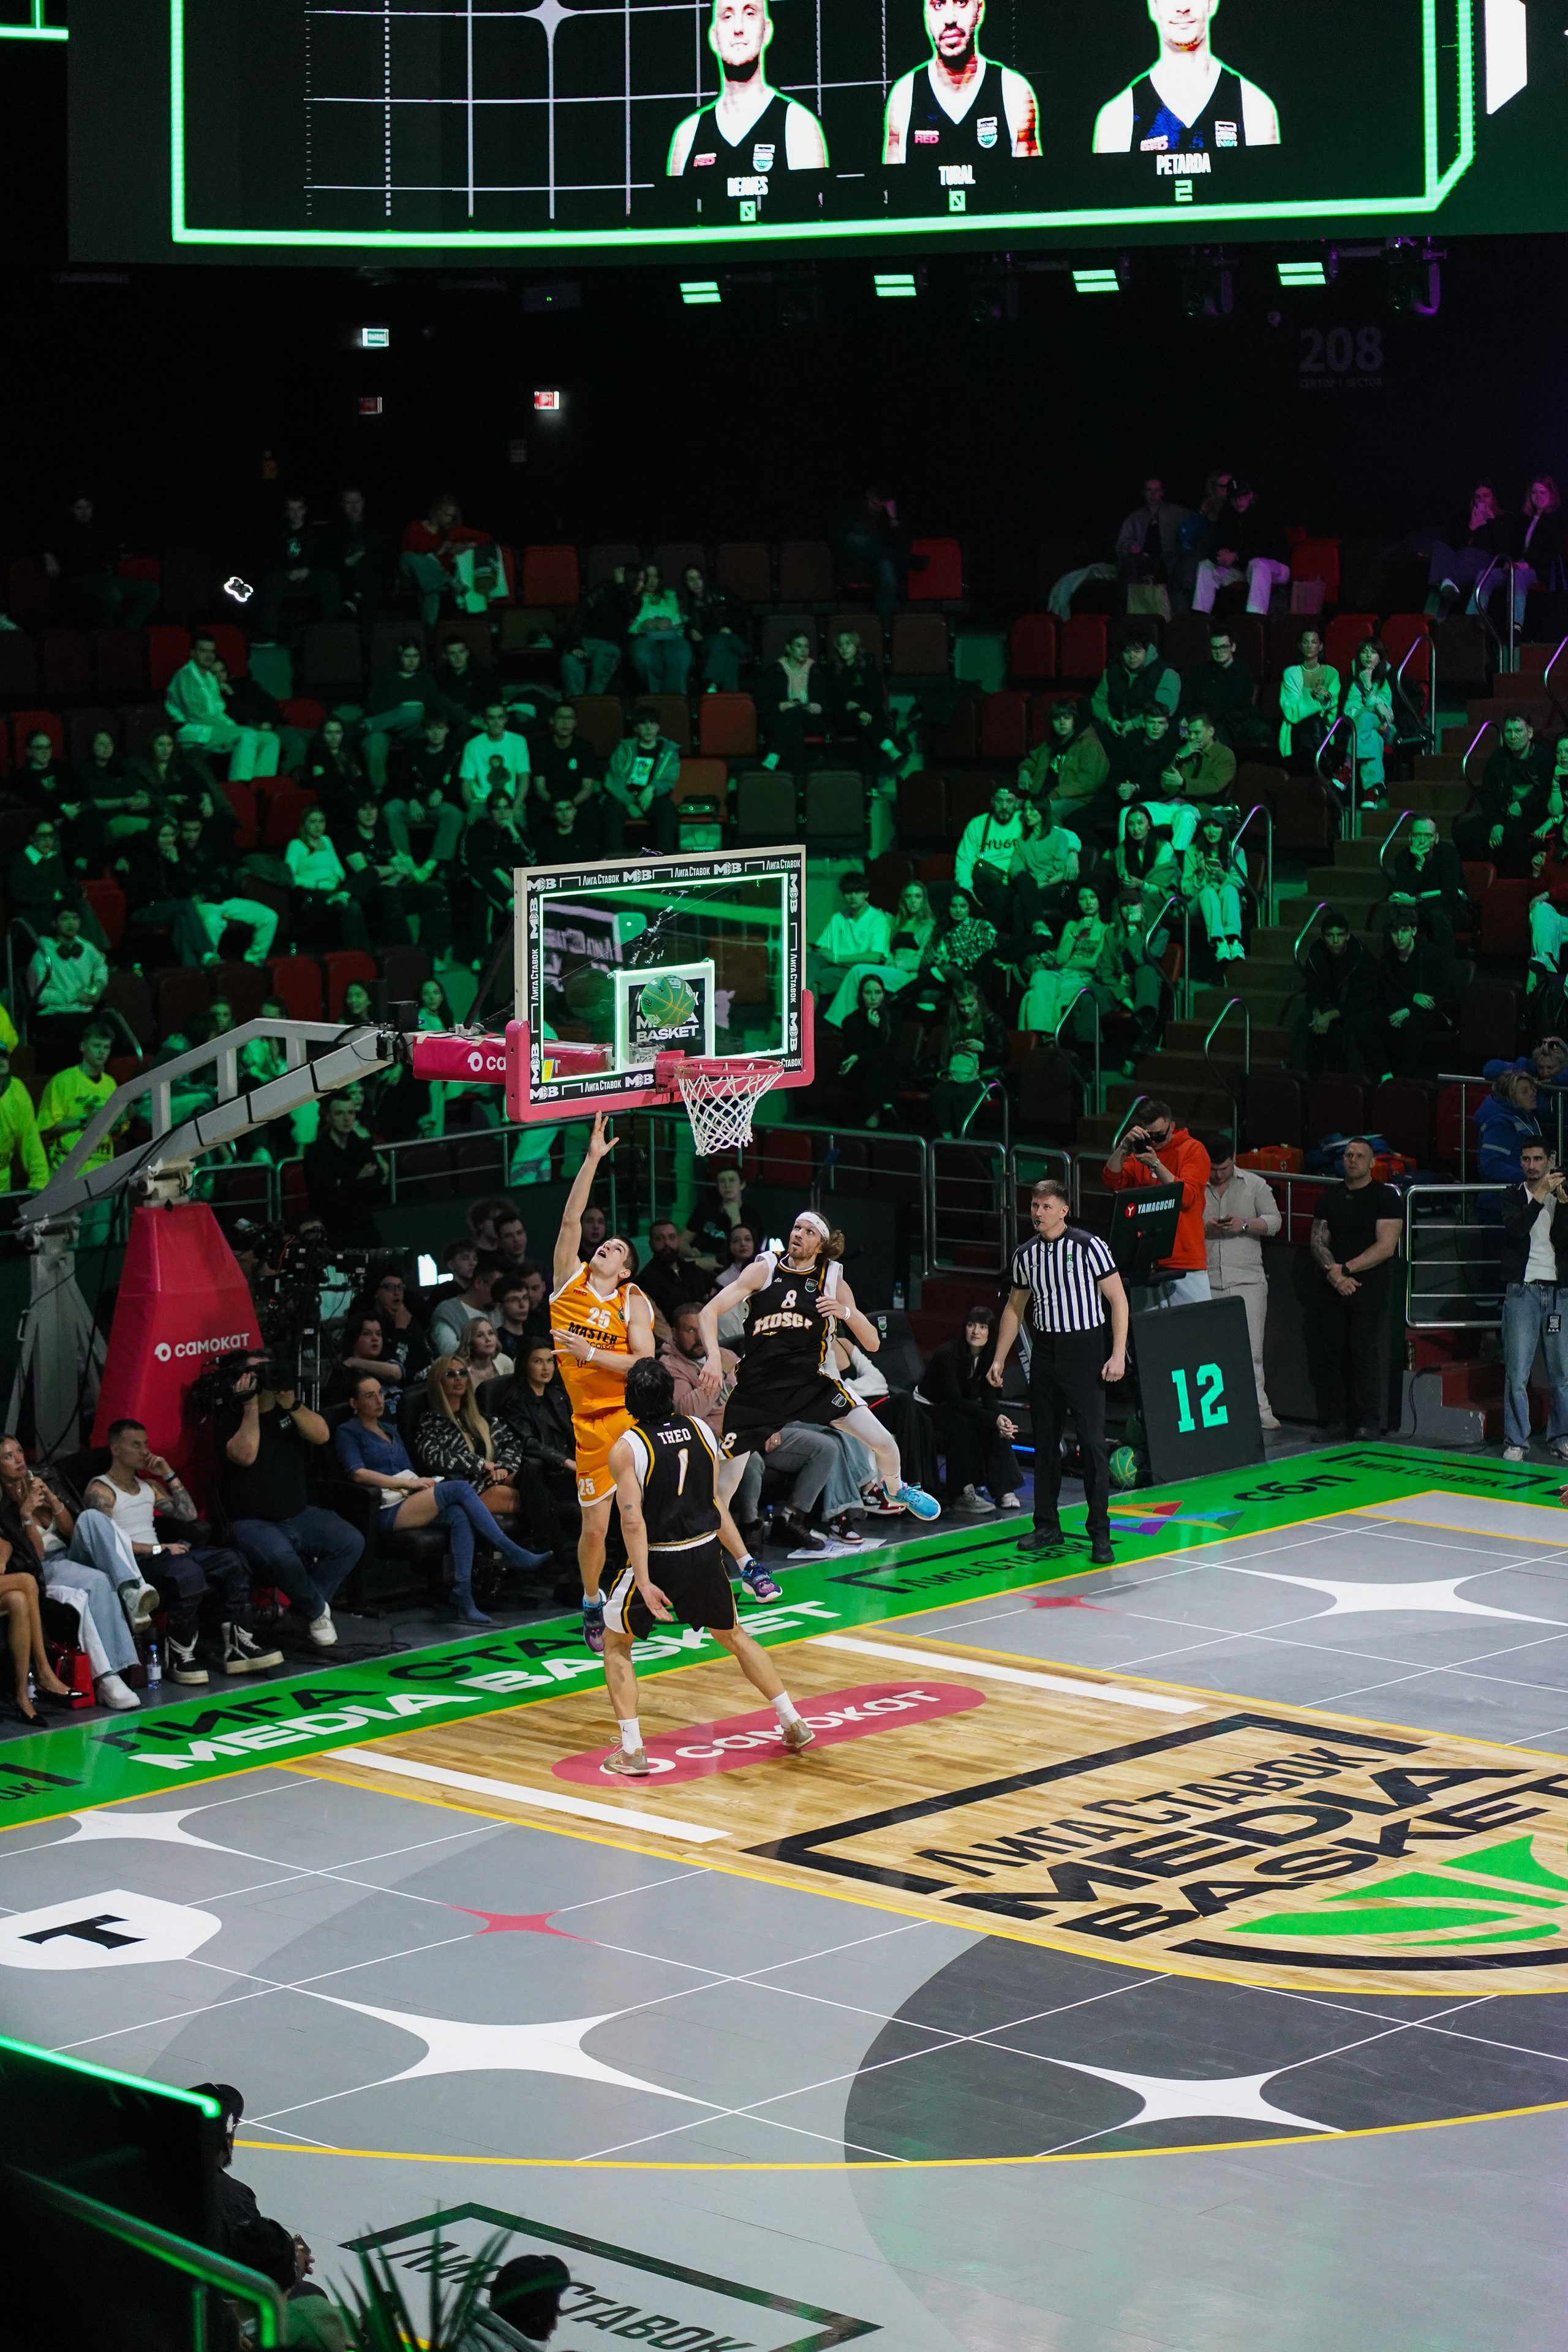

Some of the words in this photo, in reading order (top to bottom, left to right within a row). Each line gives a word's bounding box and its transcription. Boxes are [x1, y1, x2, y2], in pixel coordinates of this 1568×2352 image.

[1156, 153, 1212, 175] PETARDA
[1175, 179, 1193, 202] 2
[1299, 326, 1383, 372] 208
[636, 1025, 699, 1042] BASKET
[1137, 1199, 1175, 1214] YAMAGUCHI
[781, 1289, 797, 1309] 8
[586, 1307, 611, 1329] 25
[568, 1322, 617, 1344] MASTER
[175, 1333, 250, 1357] самокат
[1171, 1363, 1229, 1433] 12
[657, 1428, 692, 1444] THEO
[721, 1432, 737, 1450] 8
[677, 1448, 689, 1496] 1
[578, 1478, 595, 1496] 25
[89, 1689, 385, 1752] ЛИГА
[127, 1694, 484, 1770] MEDIA
[913, 1819, 1145, 1878] ЛИГА
[1082, 1747, 1387, 1825] СТАВОК
[940, 1768, 1537, 1921] MEDIA
